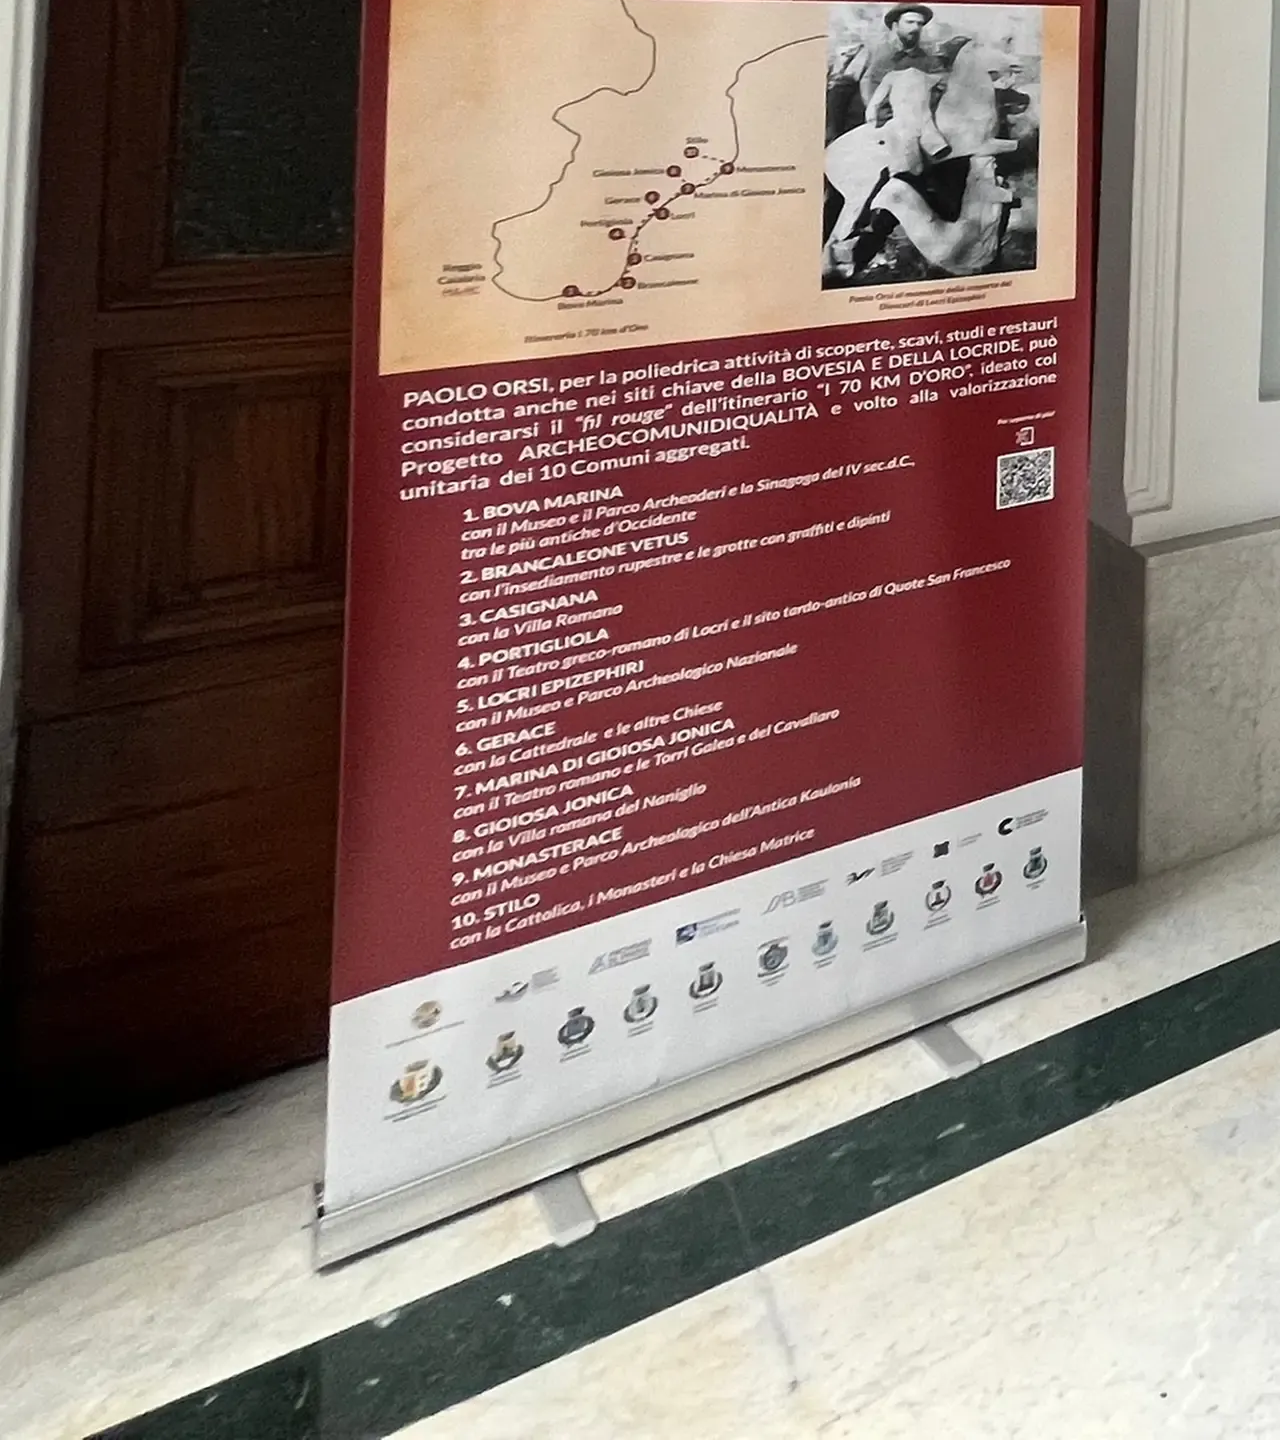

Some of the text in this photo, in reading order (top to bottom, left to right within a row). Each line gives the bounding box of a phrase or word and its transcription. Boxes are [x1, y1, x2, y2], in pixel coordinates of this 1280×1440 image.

[401, 406, 505, 432] condotta
[512, 397, 578, 418] anche
[585, 389, 617, 409] nei
[623, 384, 655, 404] siti
[660, 379, 725, 398] chiave
[730, 370, 776, 389] della
[782, 358, 866, 383] BOVESIA
[870, 355, 883, 371] E
[888, 339, 945, 369] DELLA
[1028, 334, 1058, 353] può
[403, 383, 488, 409] PAOLO
[558, 374, 595, 393] per
[599, 369, 617, 385] la
[621, 358, 720, 385] poliedrica
[723, 347, 792, 370] attività
[794, 344, 812, 361] di
[945, 324, 984, 343] studi
[986, 326, 997, 337] e
[998, 315, 1058, 336] restauri
[400, 421, 539, 454] considerarsi
[550, 418, 563, 436] il
[680, 387, 808, 417] dell'itinerario
[838, 378, 862, 395] 70
[870, 373, 901, 391] KM
[980, 358, 1028, 375] ideato
[1034, 351, 1057, 367] col
[400, 372, 1057, 478] Progetto ARCHEOCOMUNIDIQUALITÀ e volto alla valorizzazione
[399, 434, 751, 501] unitaria dei 10 Comuni aggregati.
[462, 484, 624, 523] 1. BOVA MARINA
[458, 530, 689, 585] 2. BRANCALEONE VETUS
[457, 589, 599, 628] 3. CASIGNANA
[457, 603, 624, 647] con la Villa Romana
[456, 627, 610, 670] 4. PORTIGLIOLA
[455, 659, 644, 714] 5. LOCRI EPIZEPHIRI
[454, 720, 557, 757] 6. GERACE
[451, 825, 623, 887] 9. MONASTERACE
[450, 892, 541, 931] 10. STILO
